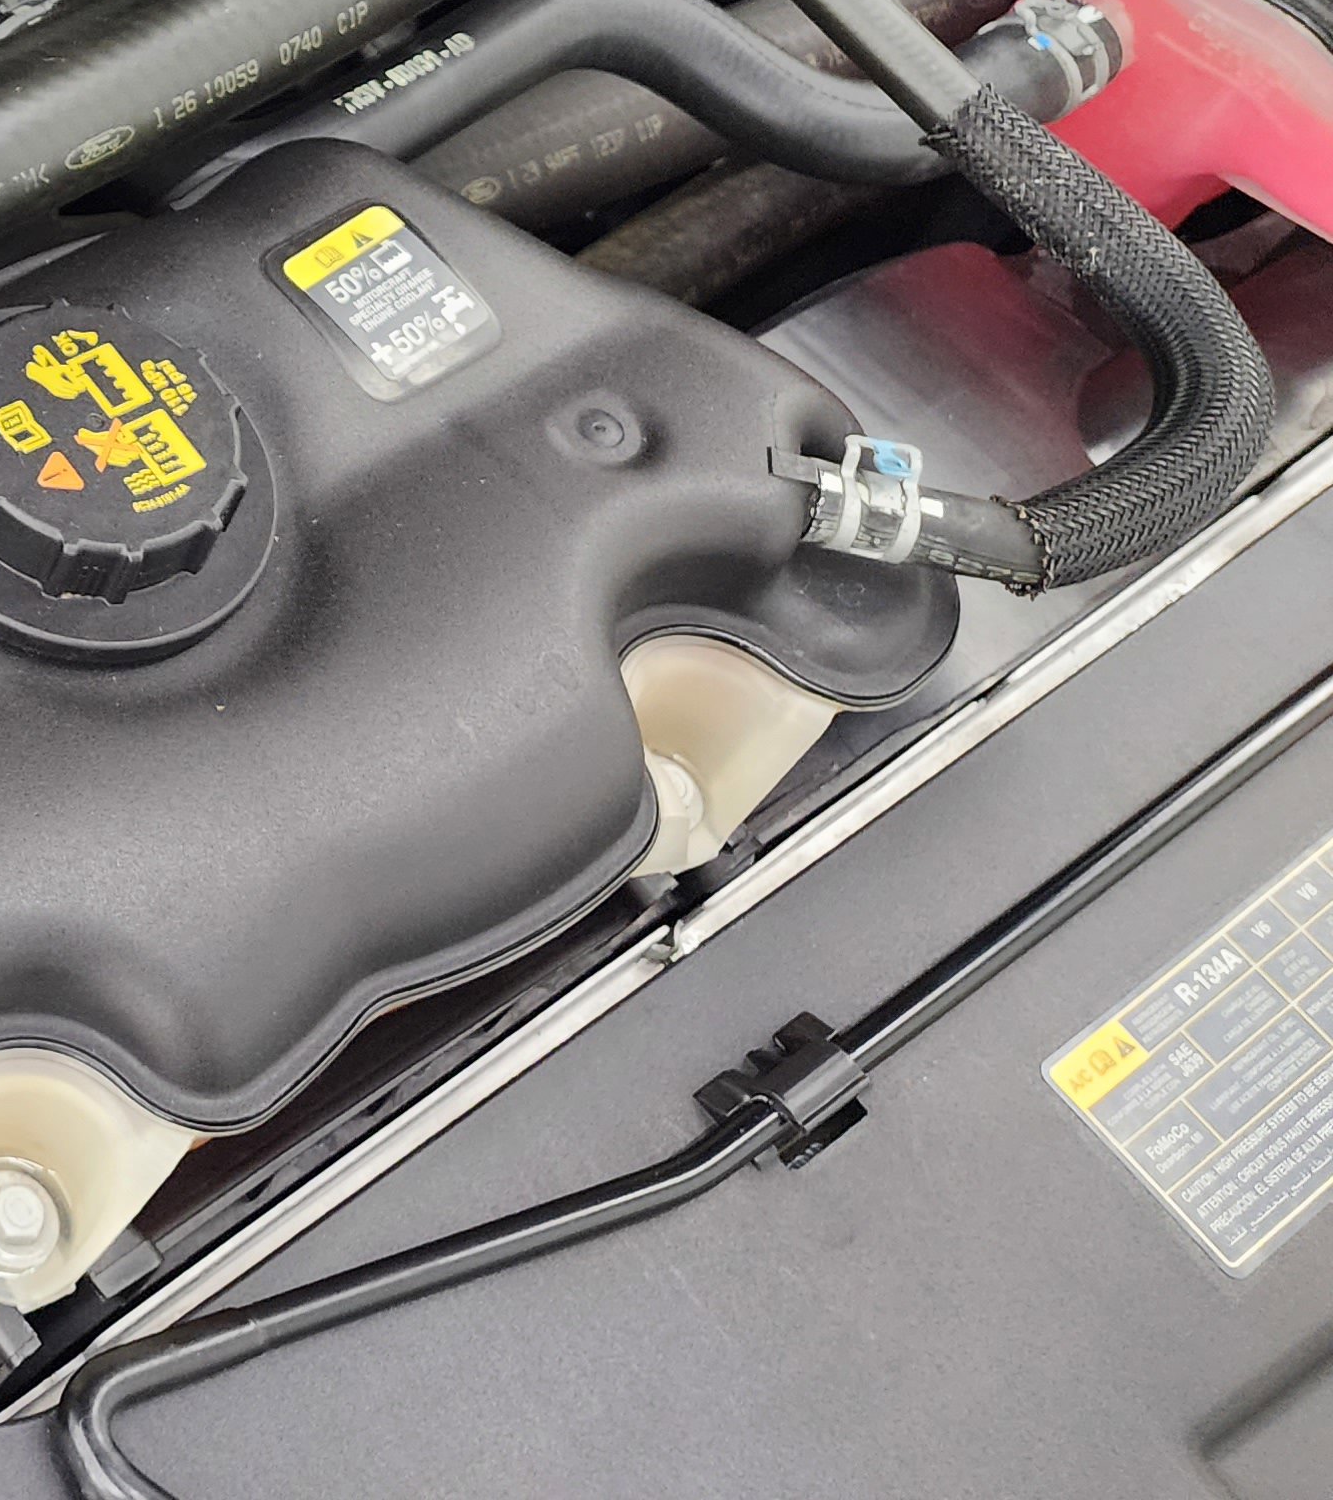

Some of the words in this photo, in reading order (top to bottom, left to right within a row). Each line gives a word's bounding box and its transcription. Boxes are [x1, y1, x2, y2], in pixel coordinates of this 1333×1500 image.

[66, 127, 133, 170] Ford
[152, 105, 165, 131] 1
[171, 89, 199, 121] 26
[278, 24, 323, 67] 0740
[324, 261, 383, 305] 50%
[348, 290, 398, 327] SPECIALTY
[396, 266, 436, 307] ORANGE
[352, 267, 414, 311] MOTORCRAFT
[361, 304, 398, 334] ENGINE
[395, 277, 439, 313] COOLANT
[51, 330, 79, 358] OK
[1250, 919, 1272, 940] V6
[1172, 947, 1244, 1007] R-134A
[1167, 1041, 1193, 1067] SAE
[1144, 1122, 1190, 1161] FoMoCo
[1213, 1151, 1235, 1174] HIGH
[1230, 1124, 1272, 1161] PRESSURE
[1267, 1099, 1300, 1133] SYSTEM
[1295, 1091, 1309, 1109] TO
[1303, 1082, 1320, 1100] BE
[1237, 1150, 1273, 1185] CIRCUIT
[1266, 1137, 1289, 1161] SOUS
[1284, 1117, 1312, 1148] HAUTE
